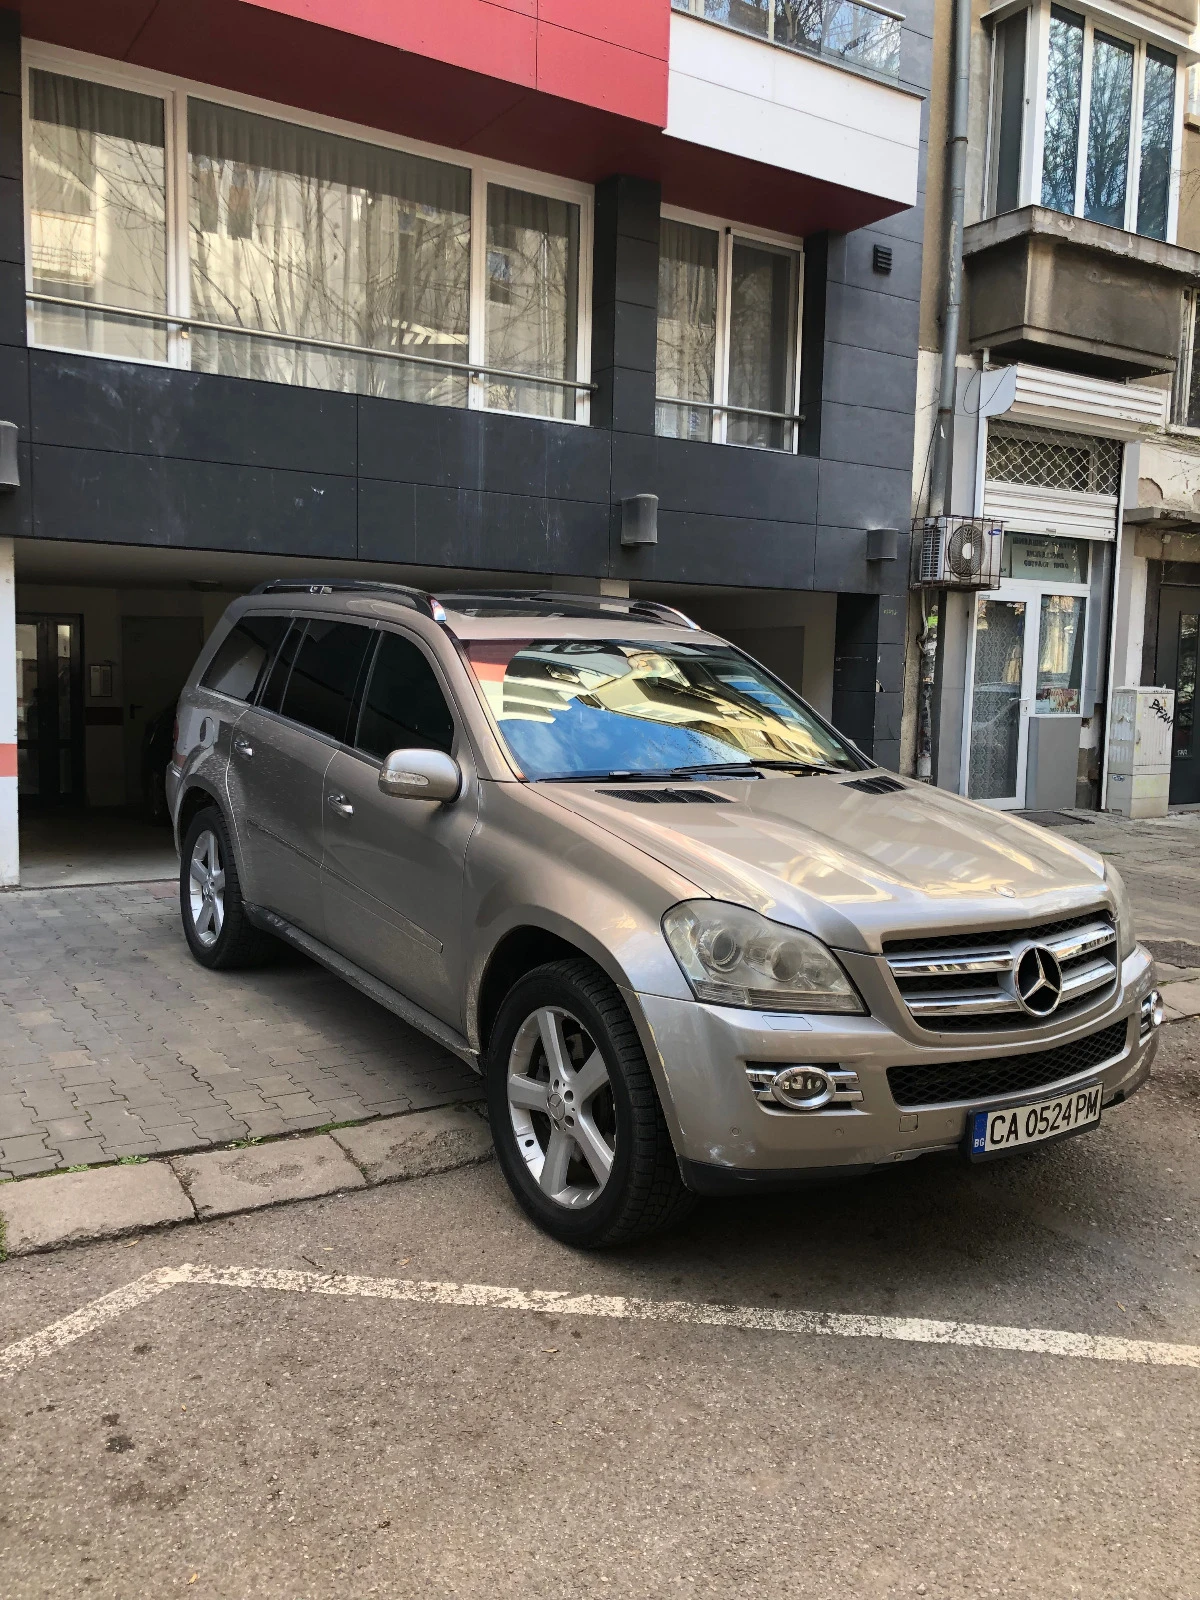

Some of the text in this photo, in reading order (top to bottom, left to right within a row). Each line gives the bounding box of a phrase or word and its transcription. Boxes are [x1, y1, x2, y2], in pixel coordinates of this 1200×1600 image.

[990, 1089, 1100, 1145] CA 0524 PM
[974, 1137, 985, 1148] BG
